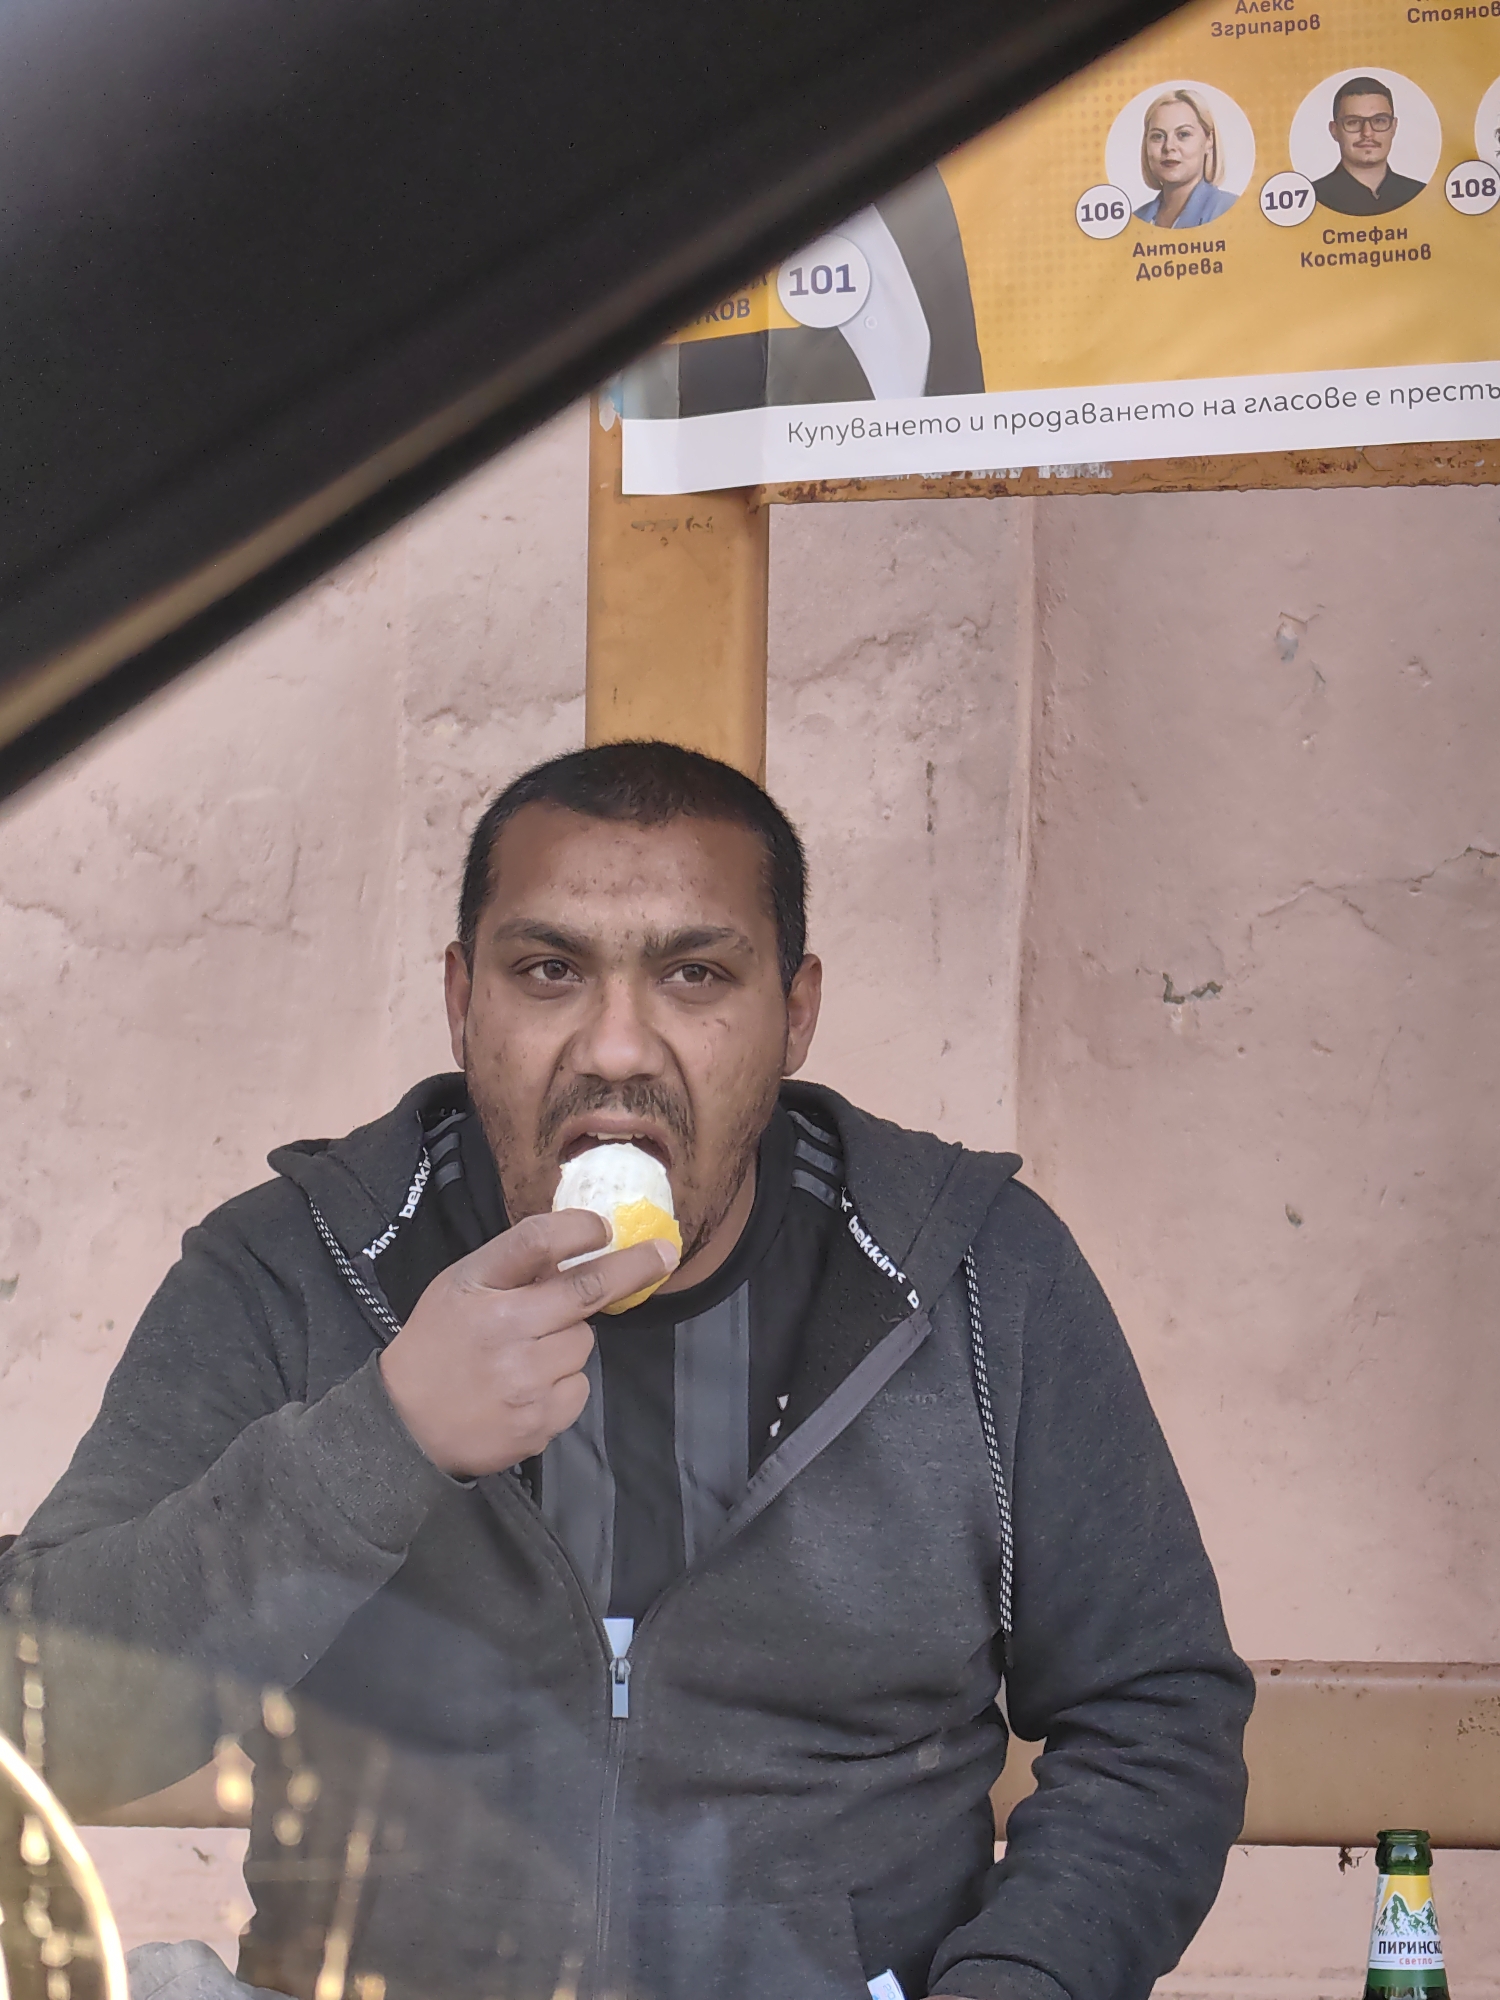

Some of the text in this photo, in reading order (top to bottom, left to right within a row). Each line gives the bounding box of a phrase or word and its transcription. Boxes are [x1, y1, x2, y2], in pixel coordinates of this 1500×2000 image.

[1235, 0, 1294, 14] Алекс
[1407, 0, 1500, 23] Стоянов
[1210, 13, 1321, 39] Згрипаров
[1450, 177, 1497, 199] 108
[1265, 189, 1310, 210] 107
[1081, 200, 1125, 222] 106
[1322, 225, 1408, 245] Стефан
[1132, 238, 1226, 258] Антония
[1300, 243, 1432, 269] Костадинов
[789, 263, 856, 296] 101
[1136, 259, 1224, 281] Добрева
[696, 298, 751, 325] КОВ
[788, 383, 1500, 448] Купуването и продаването на гласове е престъ
[1399, 1957, 1433, 1965] светло
